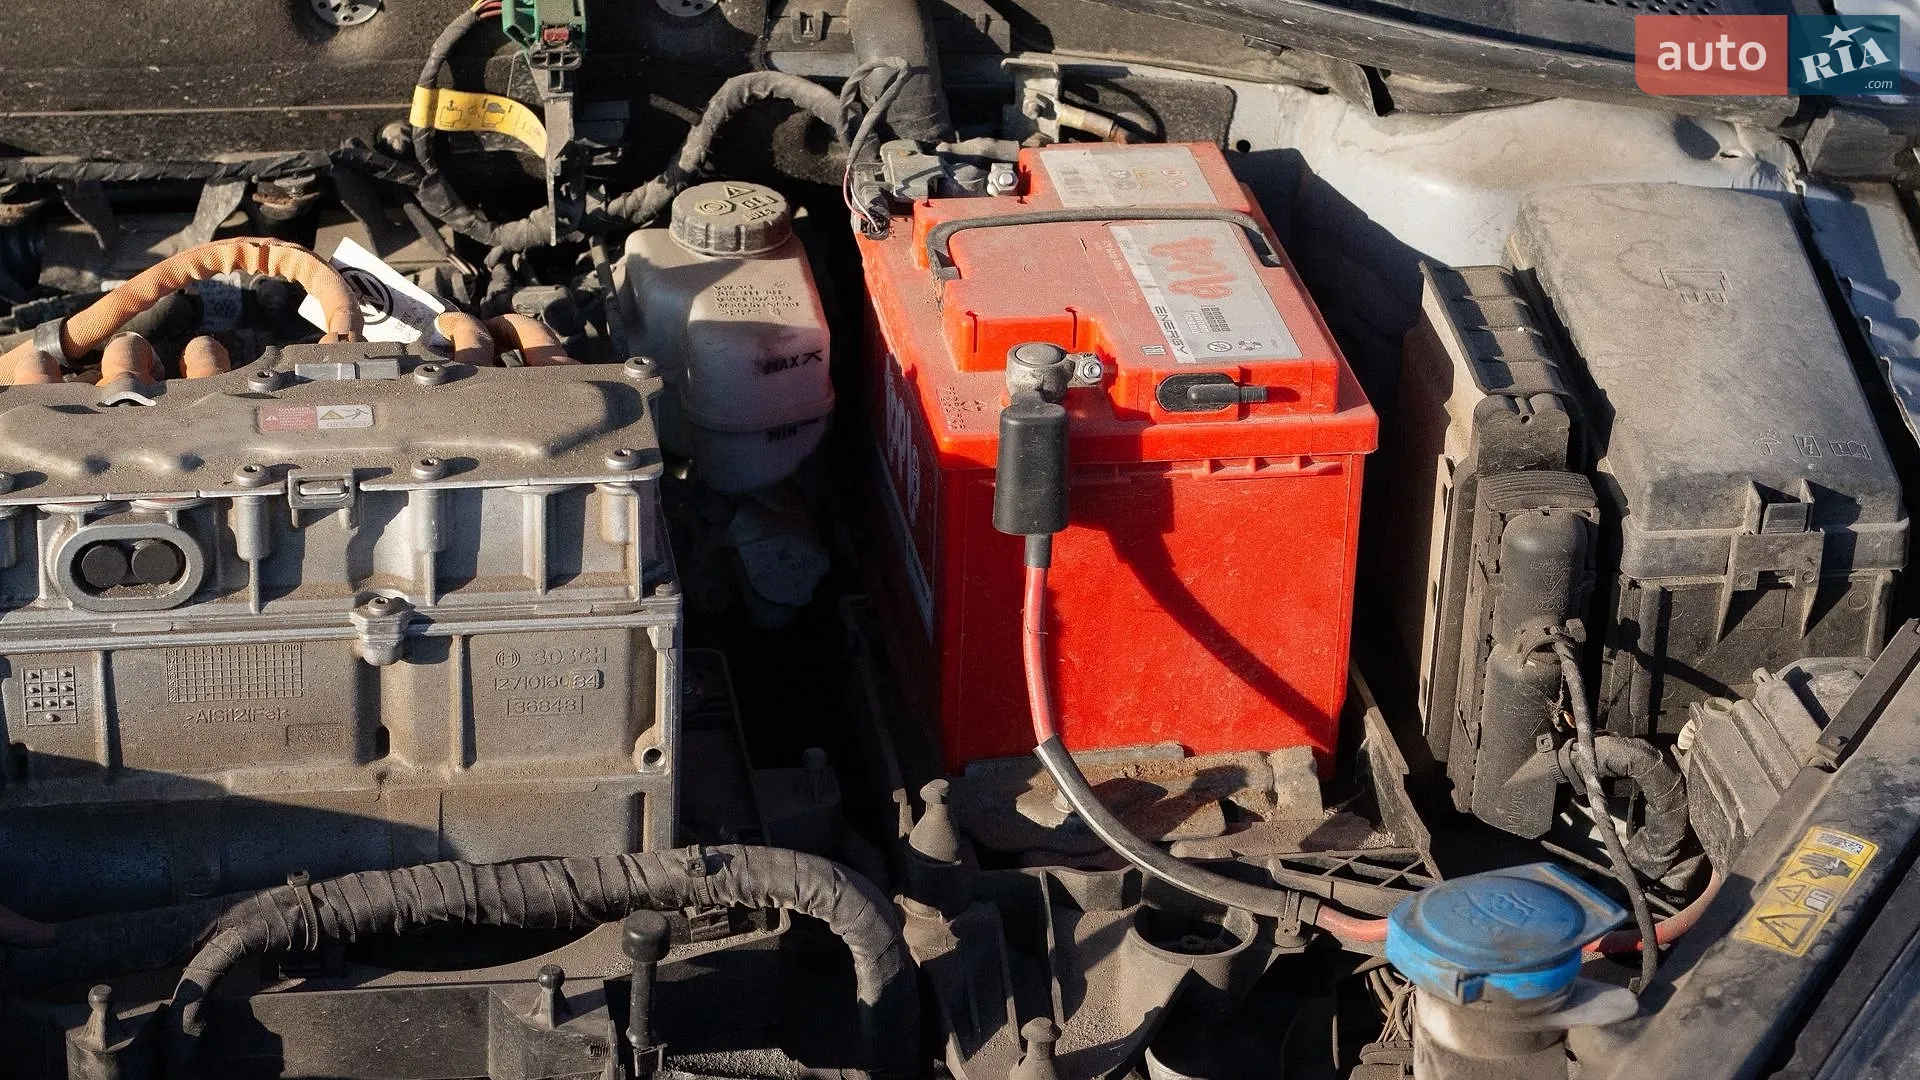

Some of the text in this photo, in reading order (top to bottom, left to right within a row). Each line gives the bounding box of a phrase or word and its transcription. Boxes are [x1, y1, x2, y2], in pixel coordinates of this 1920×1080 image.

[1154, 305, 1190, 355] ENERGY
[762, 354, 799, 375] MAX
[767, 423, 797, 442] MIN
